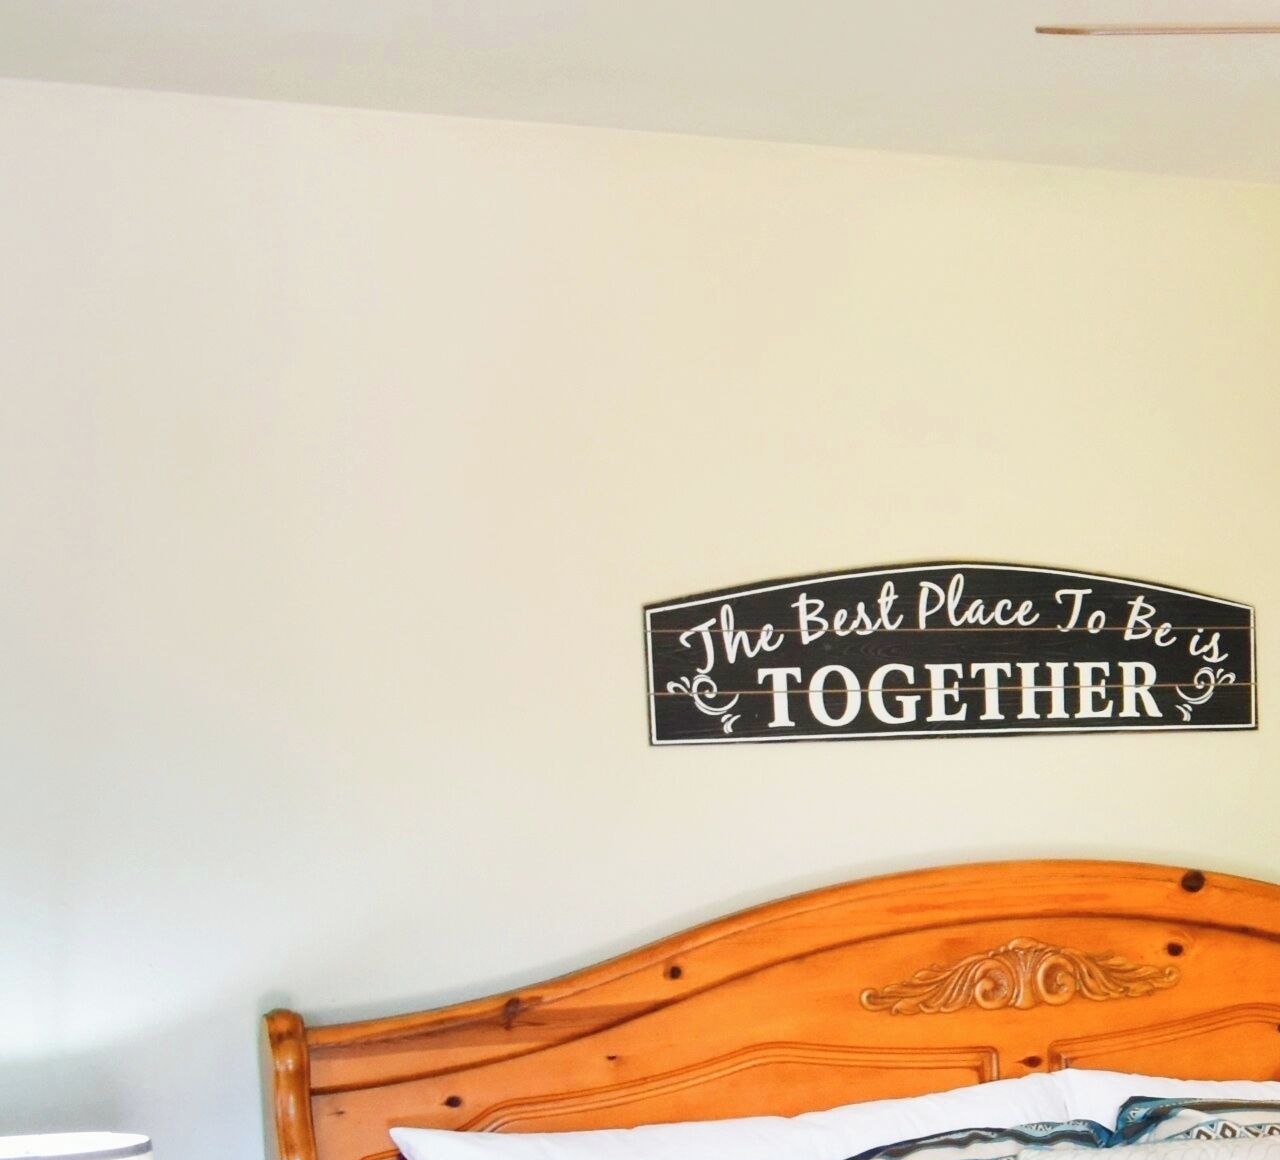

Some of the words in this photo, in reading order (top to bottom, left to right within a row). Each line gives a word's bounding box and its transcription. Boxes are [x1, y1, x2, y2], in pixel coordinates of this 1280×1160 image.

[680, 604, 785, 673] The
[792, 581, 904, 643] Best
[919, 574, 1039, 630] Place
[1055, 588, 1107, 634] To
[1125, 596, 1177, 645] Be
[1189, 628, 1229, 663] is
[758, 661, 1163, 728] TOGETHER
